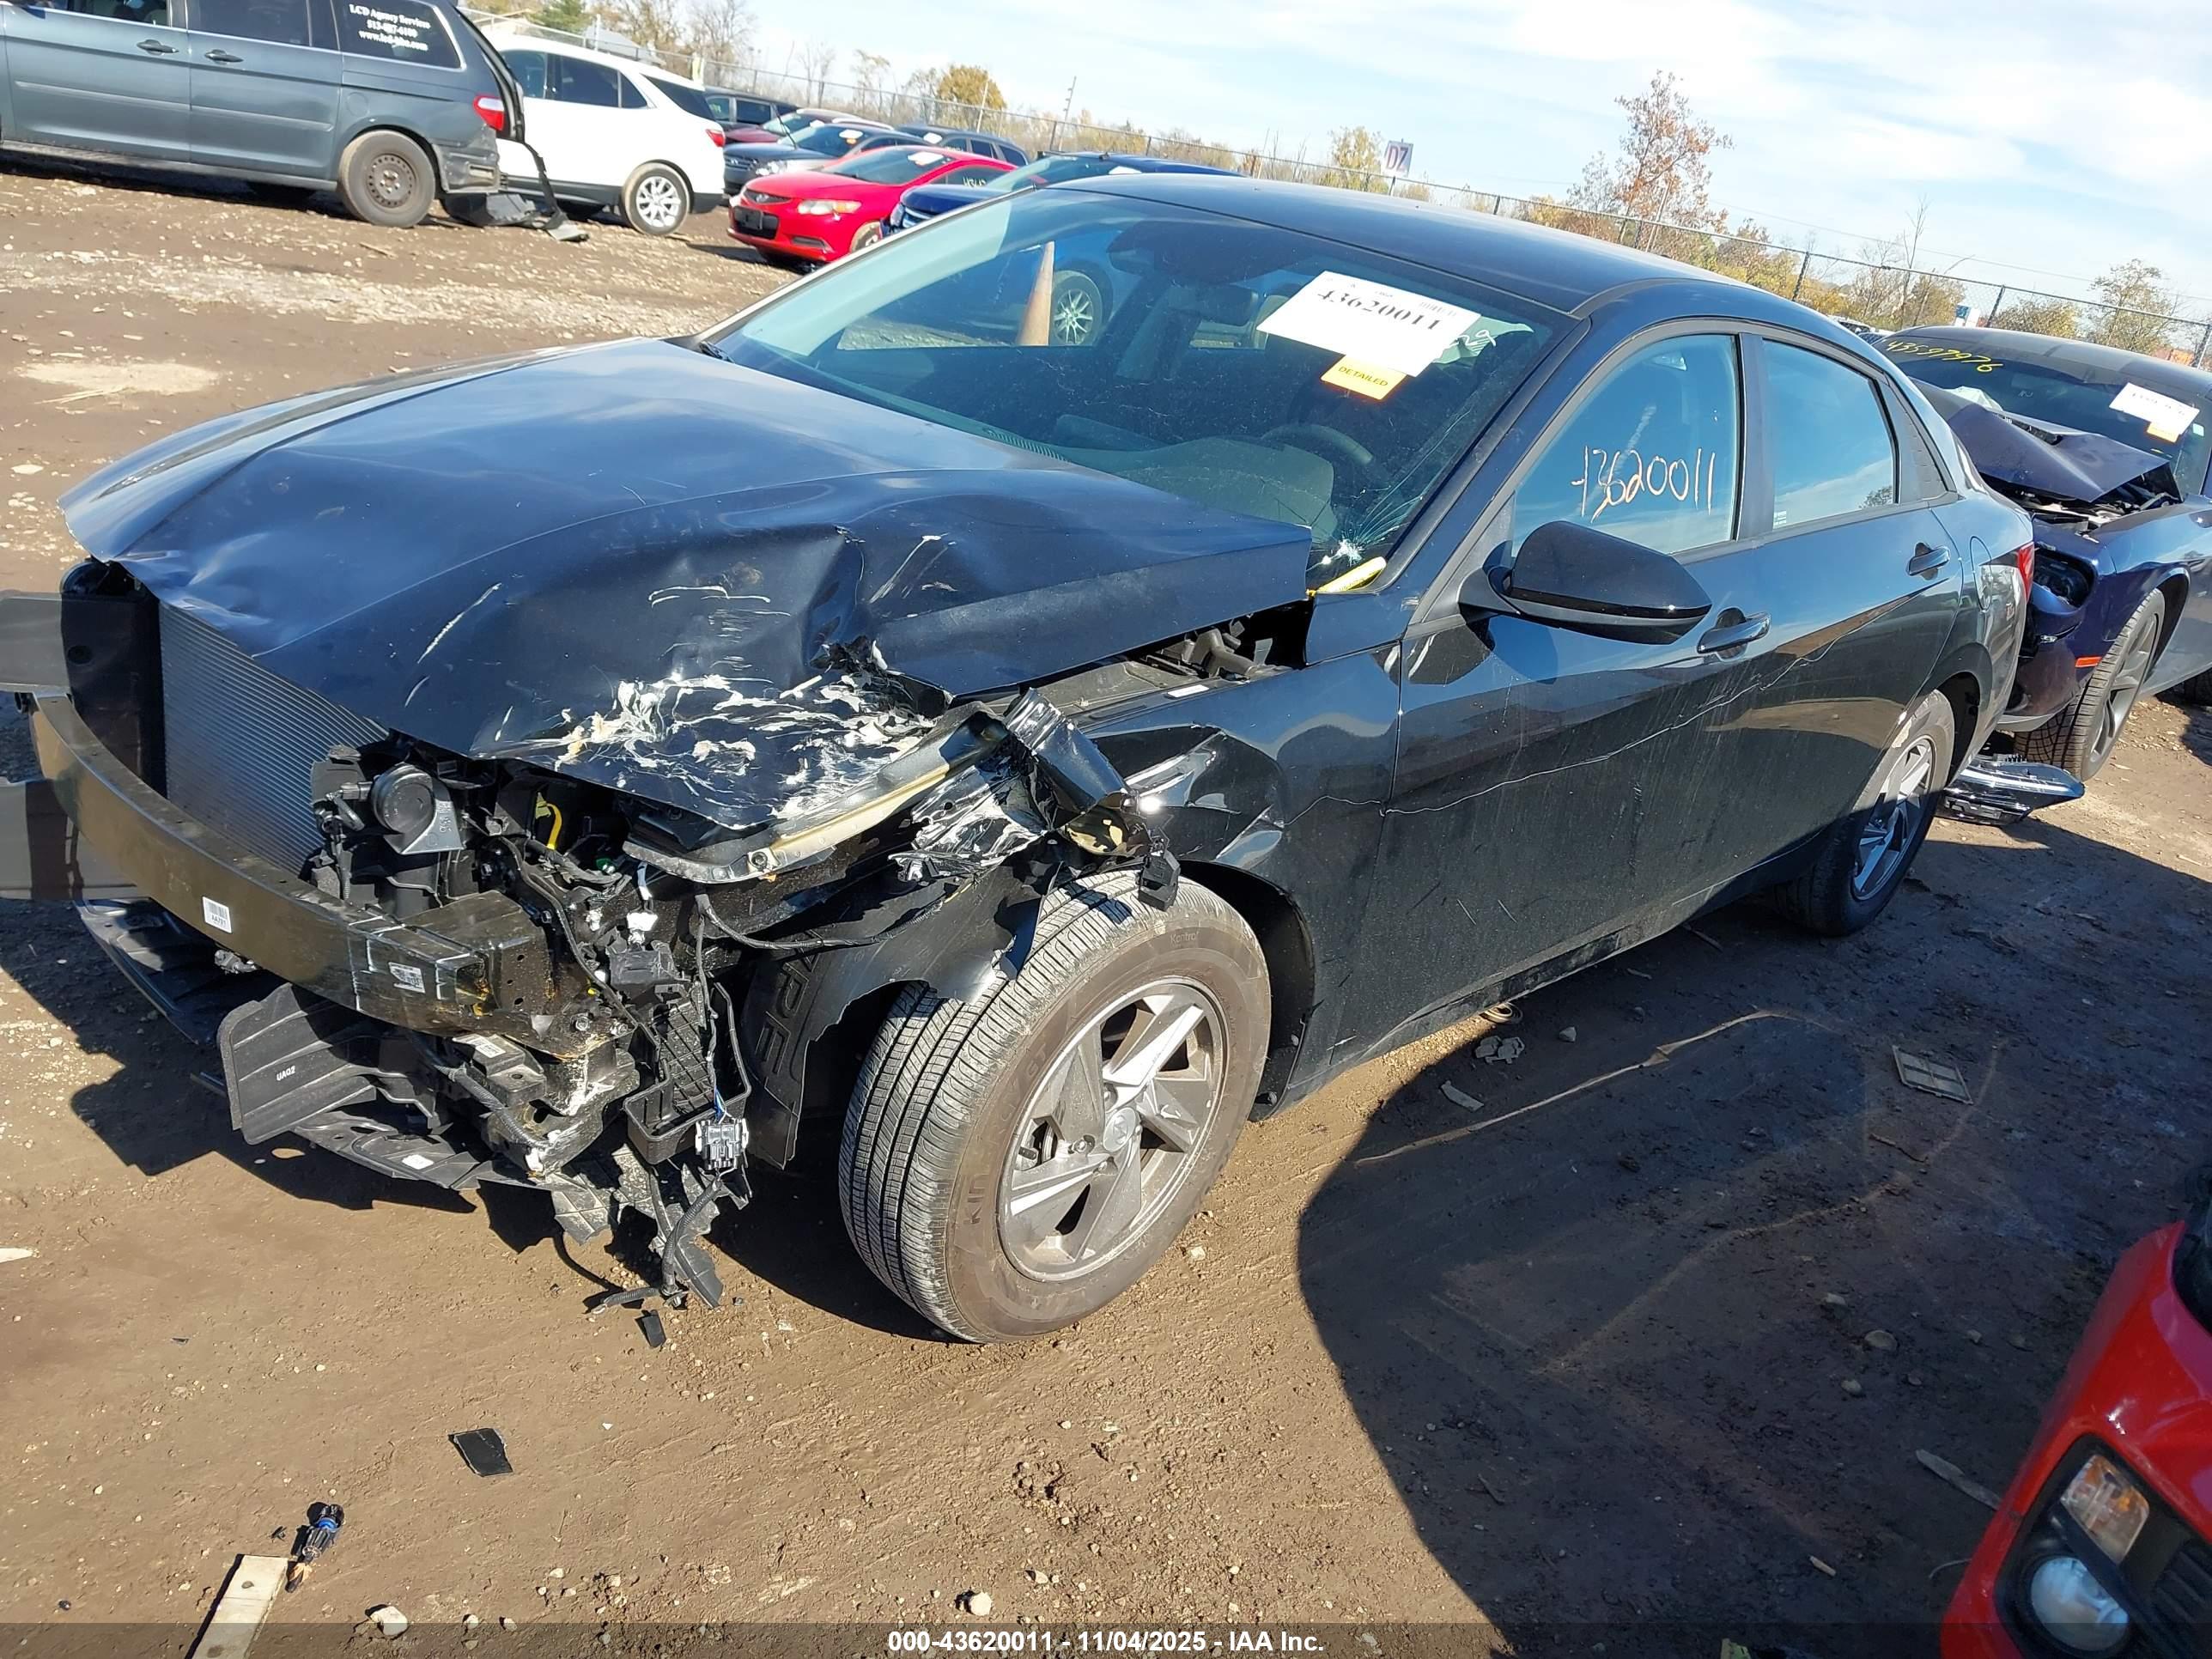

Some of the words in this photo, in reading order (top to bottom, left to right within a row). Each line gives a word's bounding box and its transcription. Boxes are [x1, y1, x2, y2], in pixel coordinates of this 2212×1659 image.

[349, 3, 370, 16] LCD
[370, 9, 398, 24] Agency
[398, 14, 431, 29] Services
[1386, 145, 1409, 171] D7
[1317, 290, 1442, 330] 43620011
[1337, 366, 1389, 387] DETAILED
